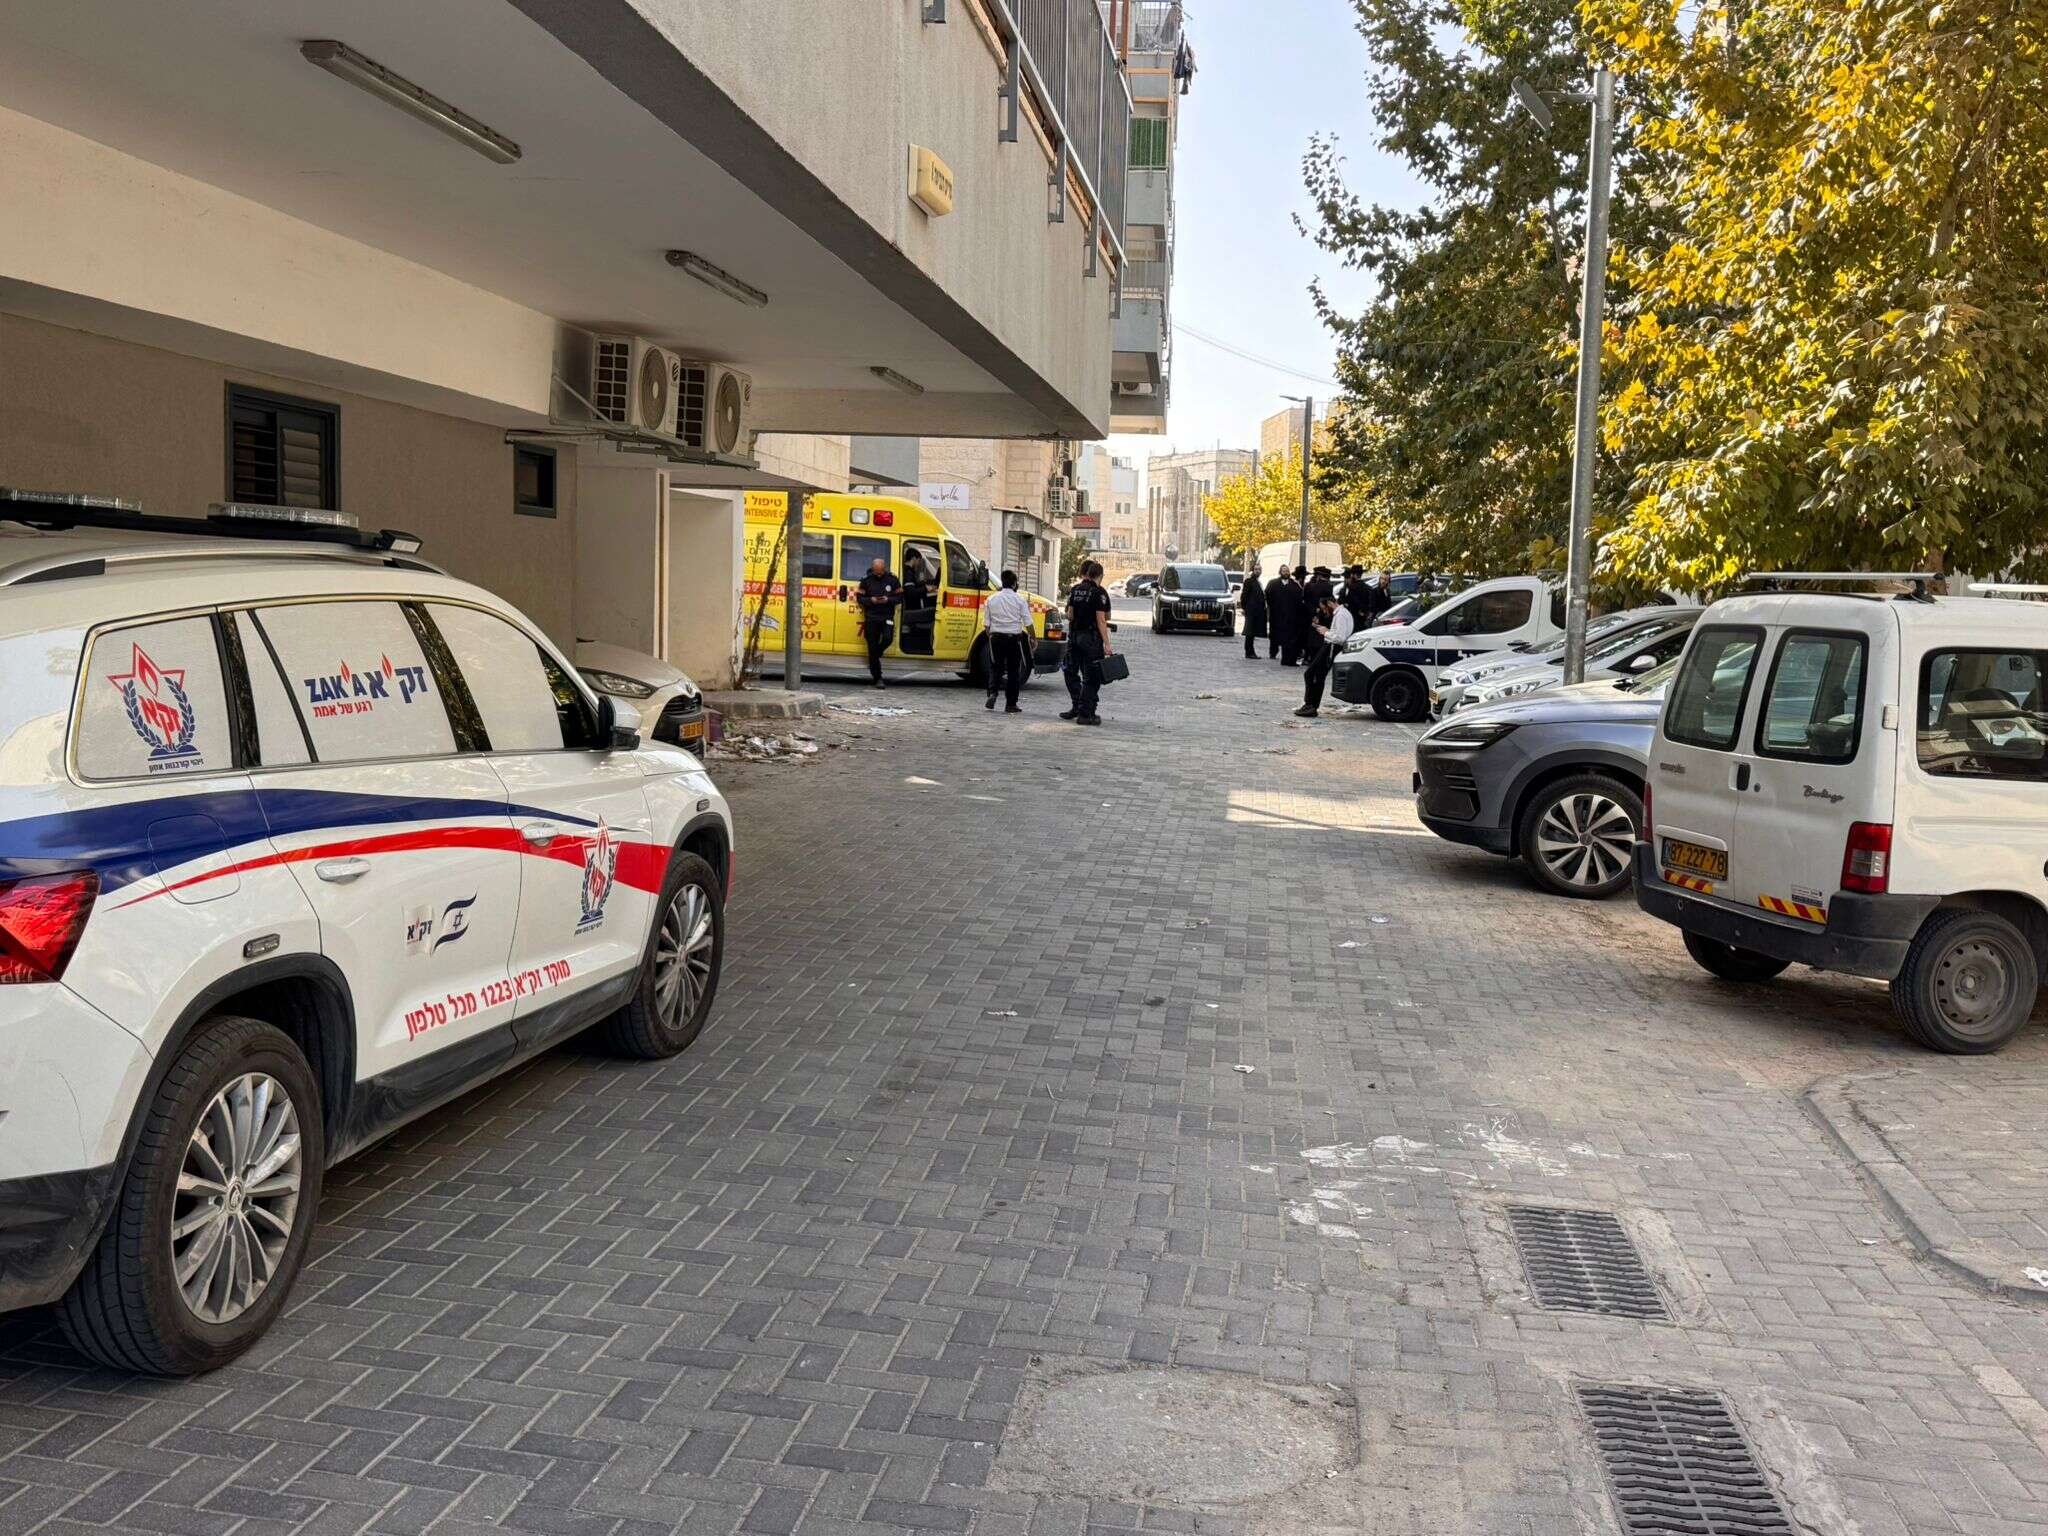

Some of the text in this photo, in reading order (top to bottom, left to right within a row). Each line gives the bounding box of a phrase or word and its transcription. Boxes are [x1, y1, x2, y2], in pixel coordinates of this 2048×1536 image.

[313, 700, 374, 718] רגע של אמת
[404, 959, 571, 1042] מוקד זק"א 1223 מכל טלפון
